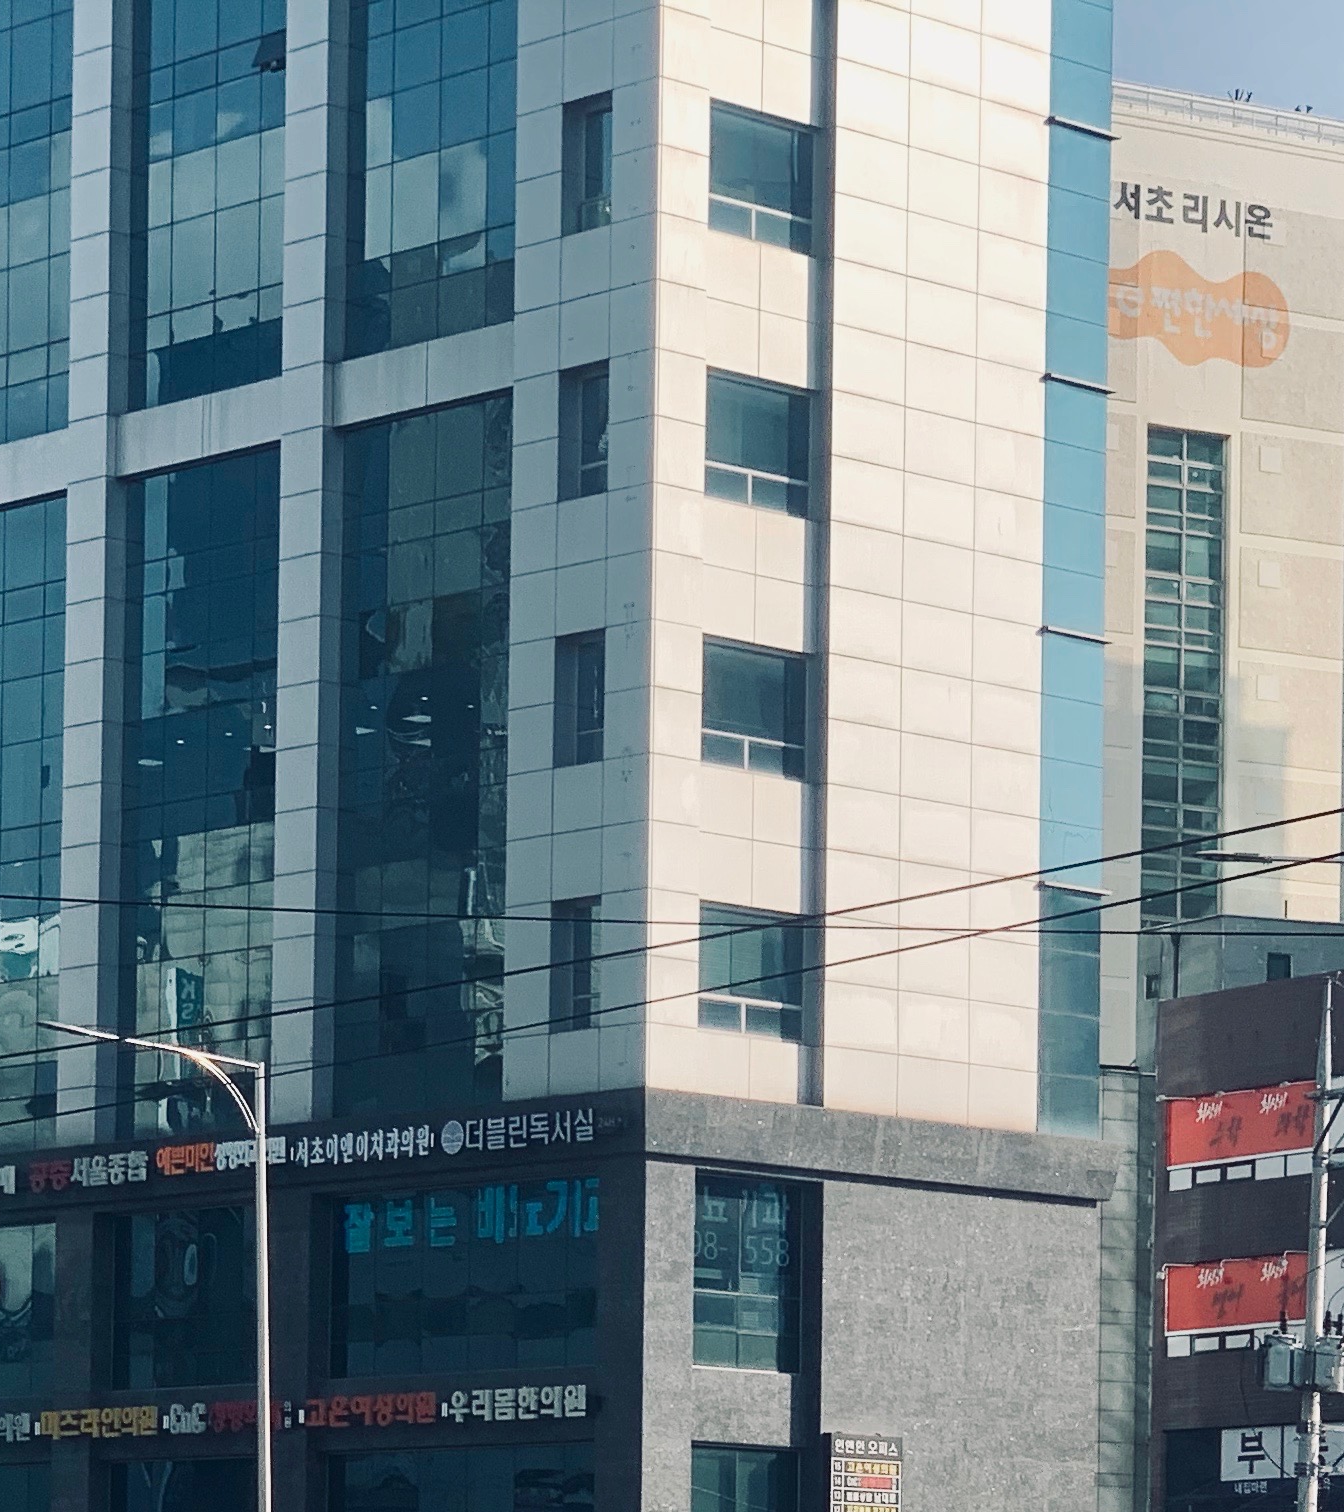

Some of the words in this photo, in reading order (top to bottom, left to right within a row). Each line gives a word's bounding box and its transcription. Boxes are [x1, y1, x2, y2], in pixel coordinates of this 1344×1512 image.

[1114, 181, 1273, 240] 서초리시온
[465, 1108, 595, 1151] 더블린독서실
[448, 1384, 587, 1424] 우리몸한의원
